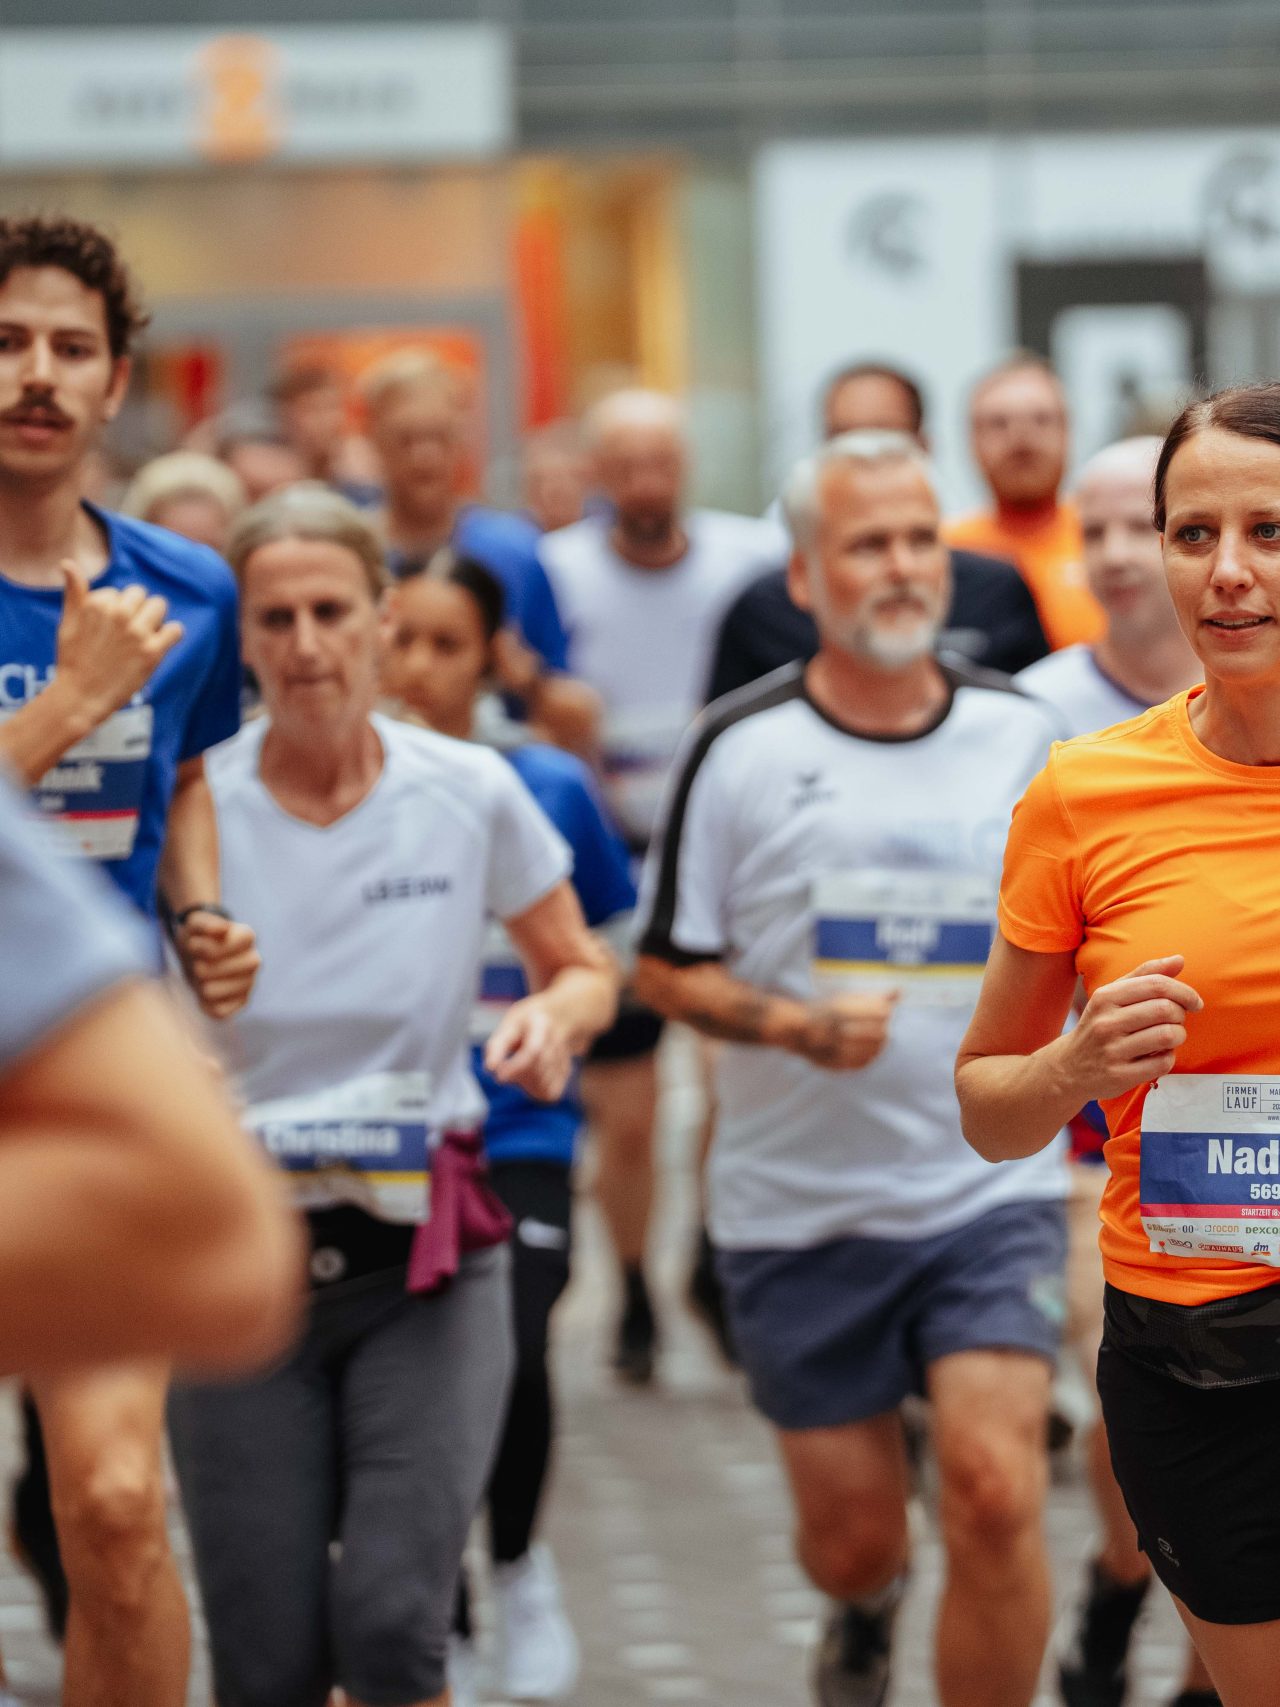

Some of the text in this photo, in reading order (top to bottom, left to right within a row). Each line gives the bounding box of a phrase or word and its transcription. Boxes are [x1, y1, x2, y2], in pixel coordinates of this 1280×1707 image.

[1226, 1086, 1258, 1096] FIRMEN
[1226, 1097, 1258, 1109] LAUF
[1241, 1208, 1271, 1217] STARTZEIT
[1253, 1242, 1269, 1252] dm
